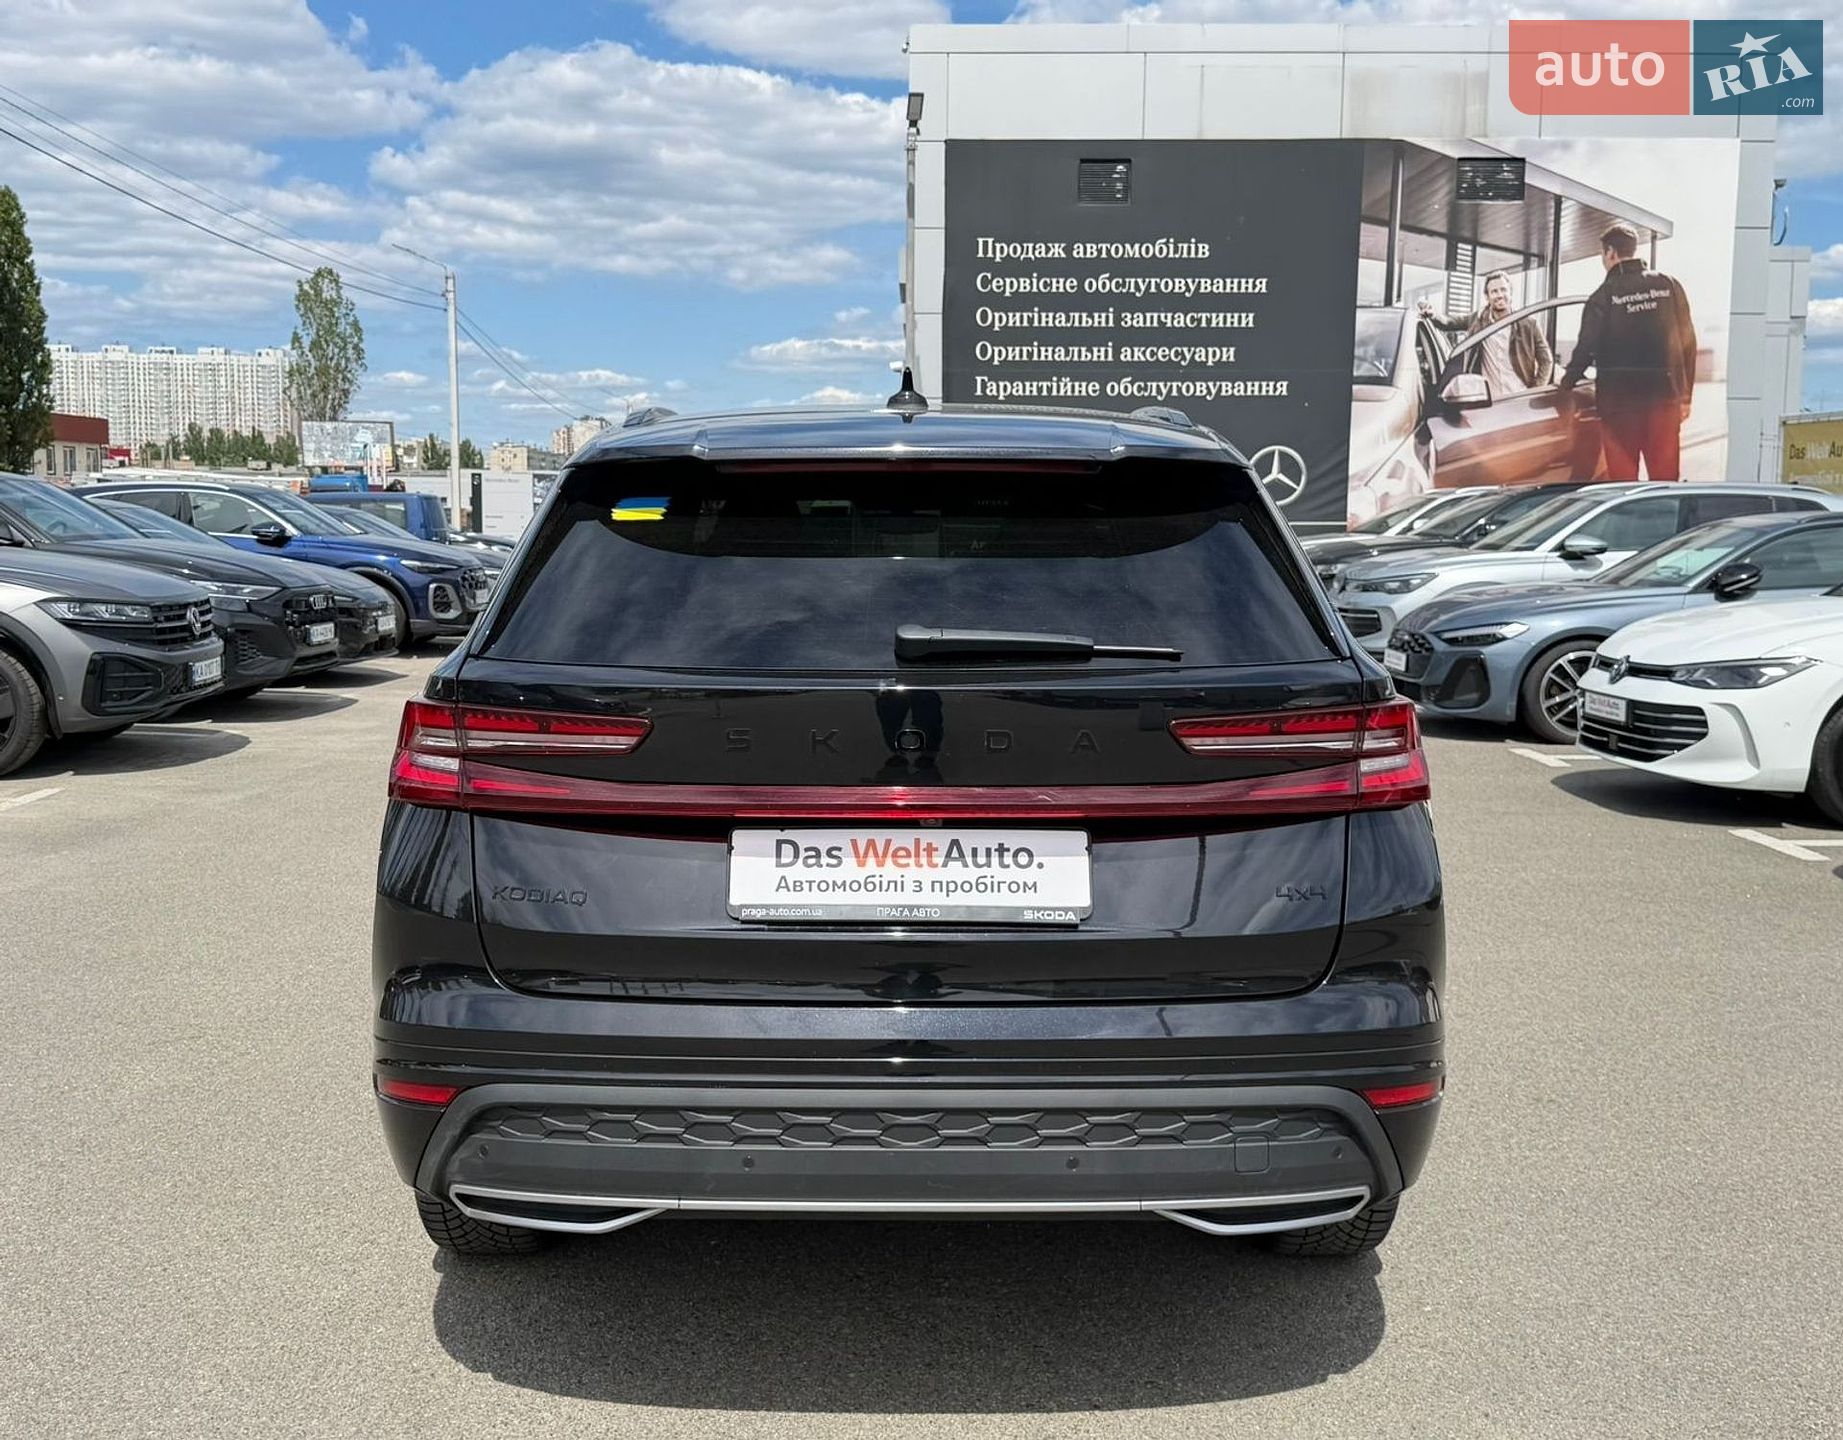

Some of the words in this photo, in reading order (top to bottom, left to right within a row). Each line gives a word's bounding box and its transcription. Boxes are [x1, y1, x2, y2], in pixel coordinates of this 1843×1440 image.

[976, 237, 1067, 262] Продаж
[1072, 237, 1210, 259] автомобілів
[976, 272, 1078, 296] Сервісне
[1083, 272, 1268, 297] обслуговування
[975, 306, 1114, 331] Оригінальні
[1120, 311, 1255, 328] запчастини
[1626, 301, 1658, 313] Service
[975, 340, 1114, 365] Оригінальні
[1119, 346, 1236, 366] аксесуари
[974, 375, 1100, 399] Гарантійне
[1105, 376, 1289, 400] обслуговування
[775, 838, 843, 869] Das
[849, 837, 1045, 870] WeltAuto.
[492, 886, 588, 906] KODIAQ
[775, 874, 905, 893] Автомобілі
[912, 879, 923, 893] з
[930, 875, 1038, 895] пробігом
[741, 908, 823, 918] praga-auto.com.ua
[876, 907, 910, 917] ПРАГА
[911, 907, 940, 917] АВТО
